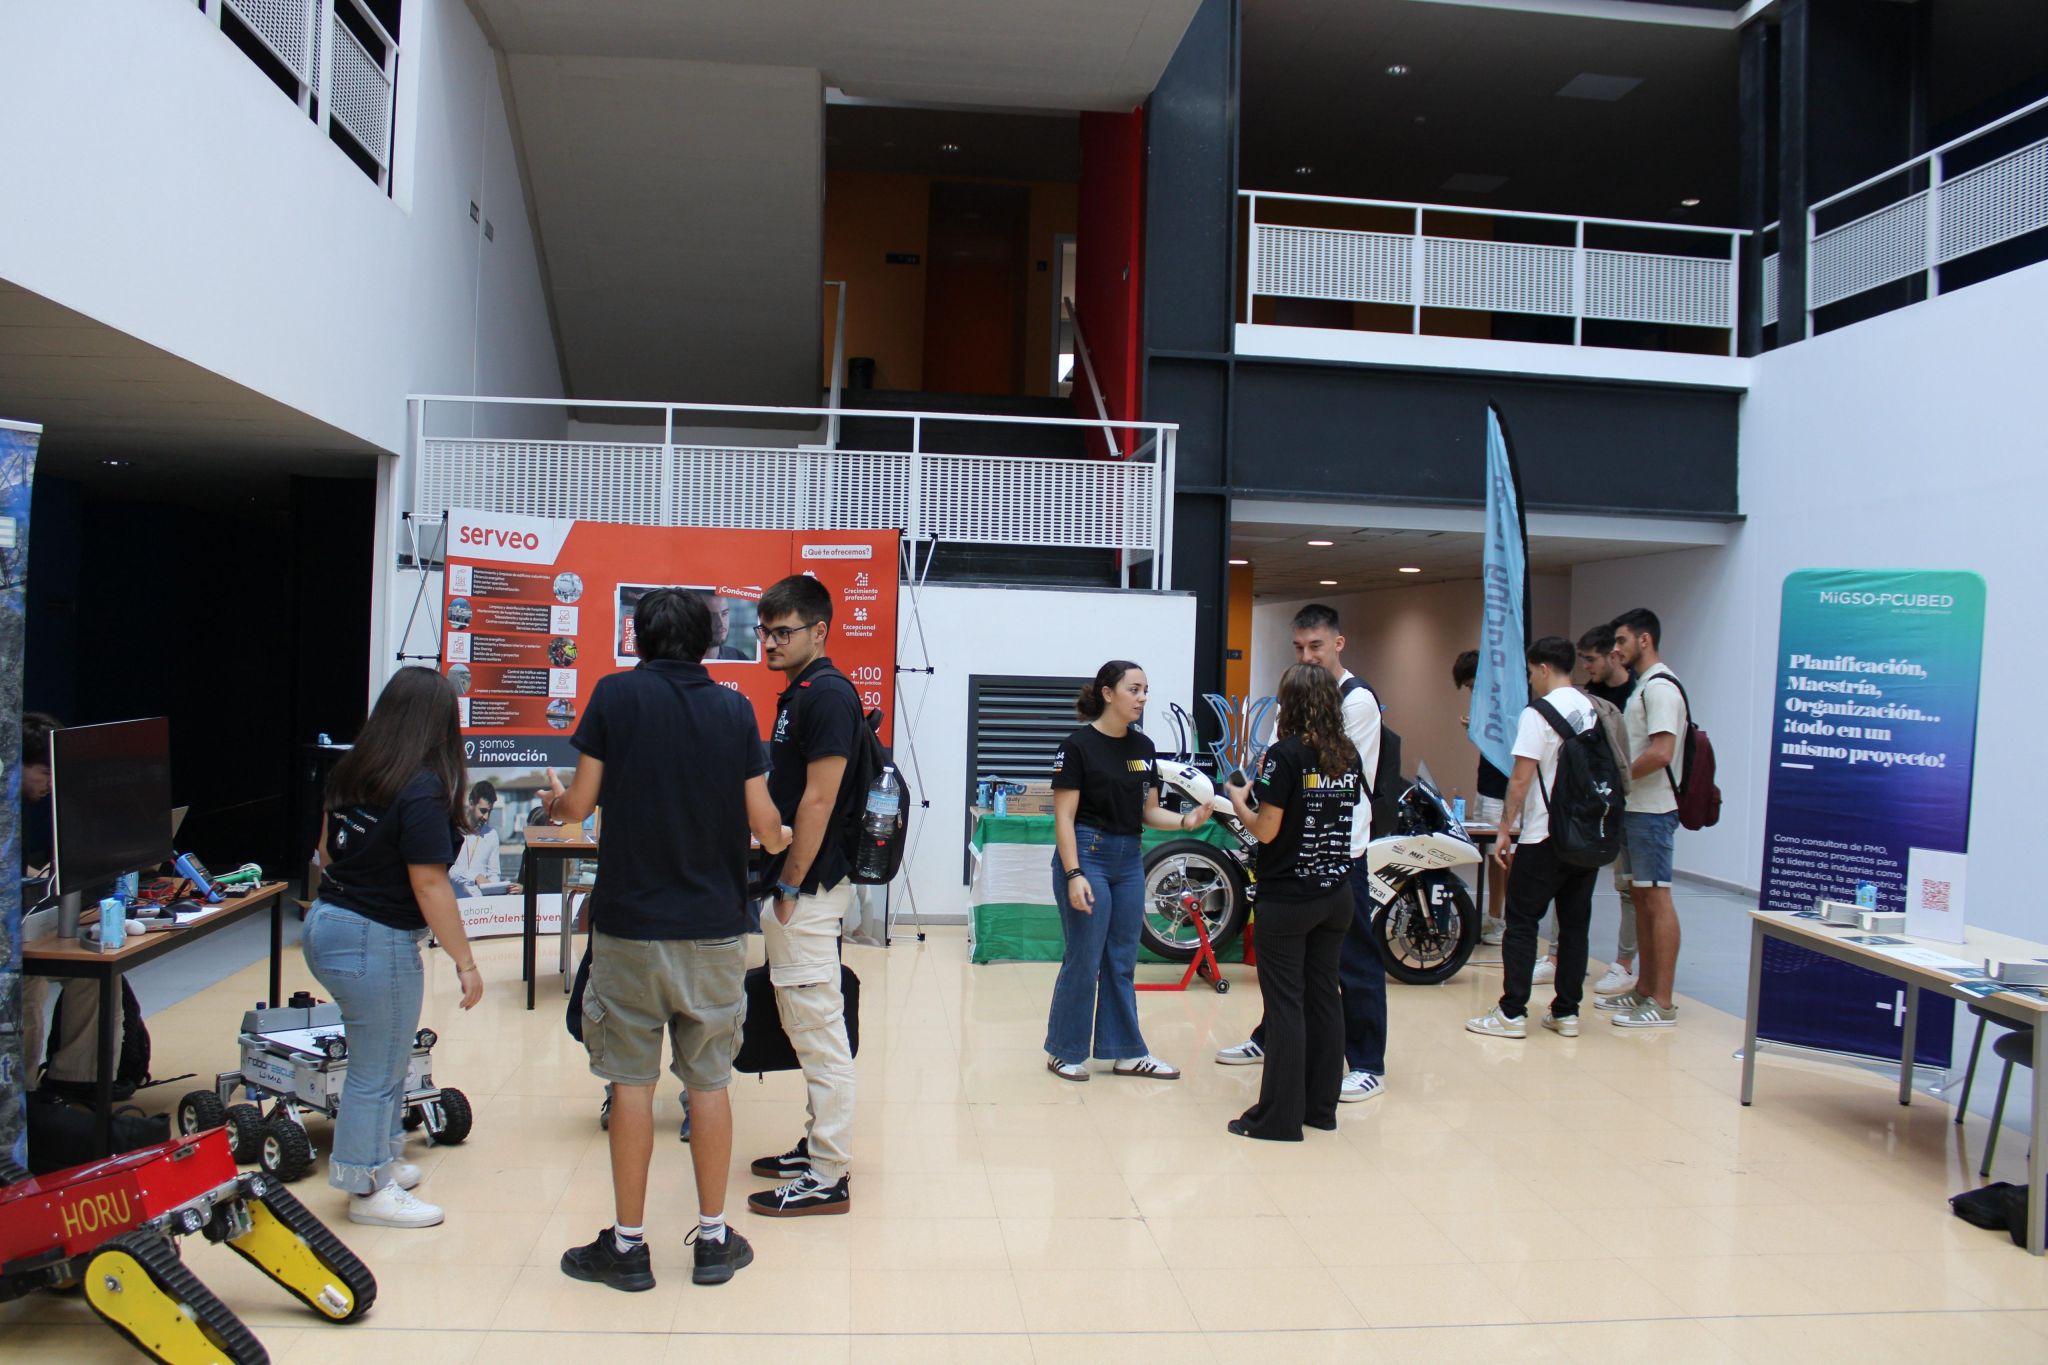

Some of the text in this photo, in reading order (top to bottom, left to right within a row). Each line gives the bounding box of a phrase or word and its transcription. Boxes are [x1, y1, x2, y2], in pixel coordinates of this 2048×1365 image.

[460, 525, 539, 550] serveo
[830, 548, 870, 556] ofrecemos?
[850, 666, 882, 680] +100
[1789, 654, 1927, 679] Planificación,
[1786, 675, 1882, 699] Maestría,
[1785, 697, 1941, 722] Organización...
[1784, 719, 1891, 740] ¡todo en un
[480, 740, 515, 748] somos
[480, 749, 547, 762] innovación
[1781, 740, 1945, 768] mismo proyecto!
[1774, 834, 1800, 844] Como
[1802, 837, 1848, 849] consultora
[1850, 842, 1862, 851] de
[1773, 846, 1897, 867] gestionamos proyectos para
[1772, 856, 1784, 864] los
[1817, 860, 1829, 869] de
[1831, 862, 1874, 875] industrias
[1876, 870, 1902, 878] como
[1793, 891, 1812, 900] vida,
[1820, 884, 1828, 892] la
[1876, 891, 1887, 900] de
[464, 906, 493, 916] ahora!
[1768, 900, 1802, 911] muchas
[61, 1189, 131, 1238] HORU
